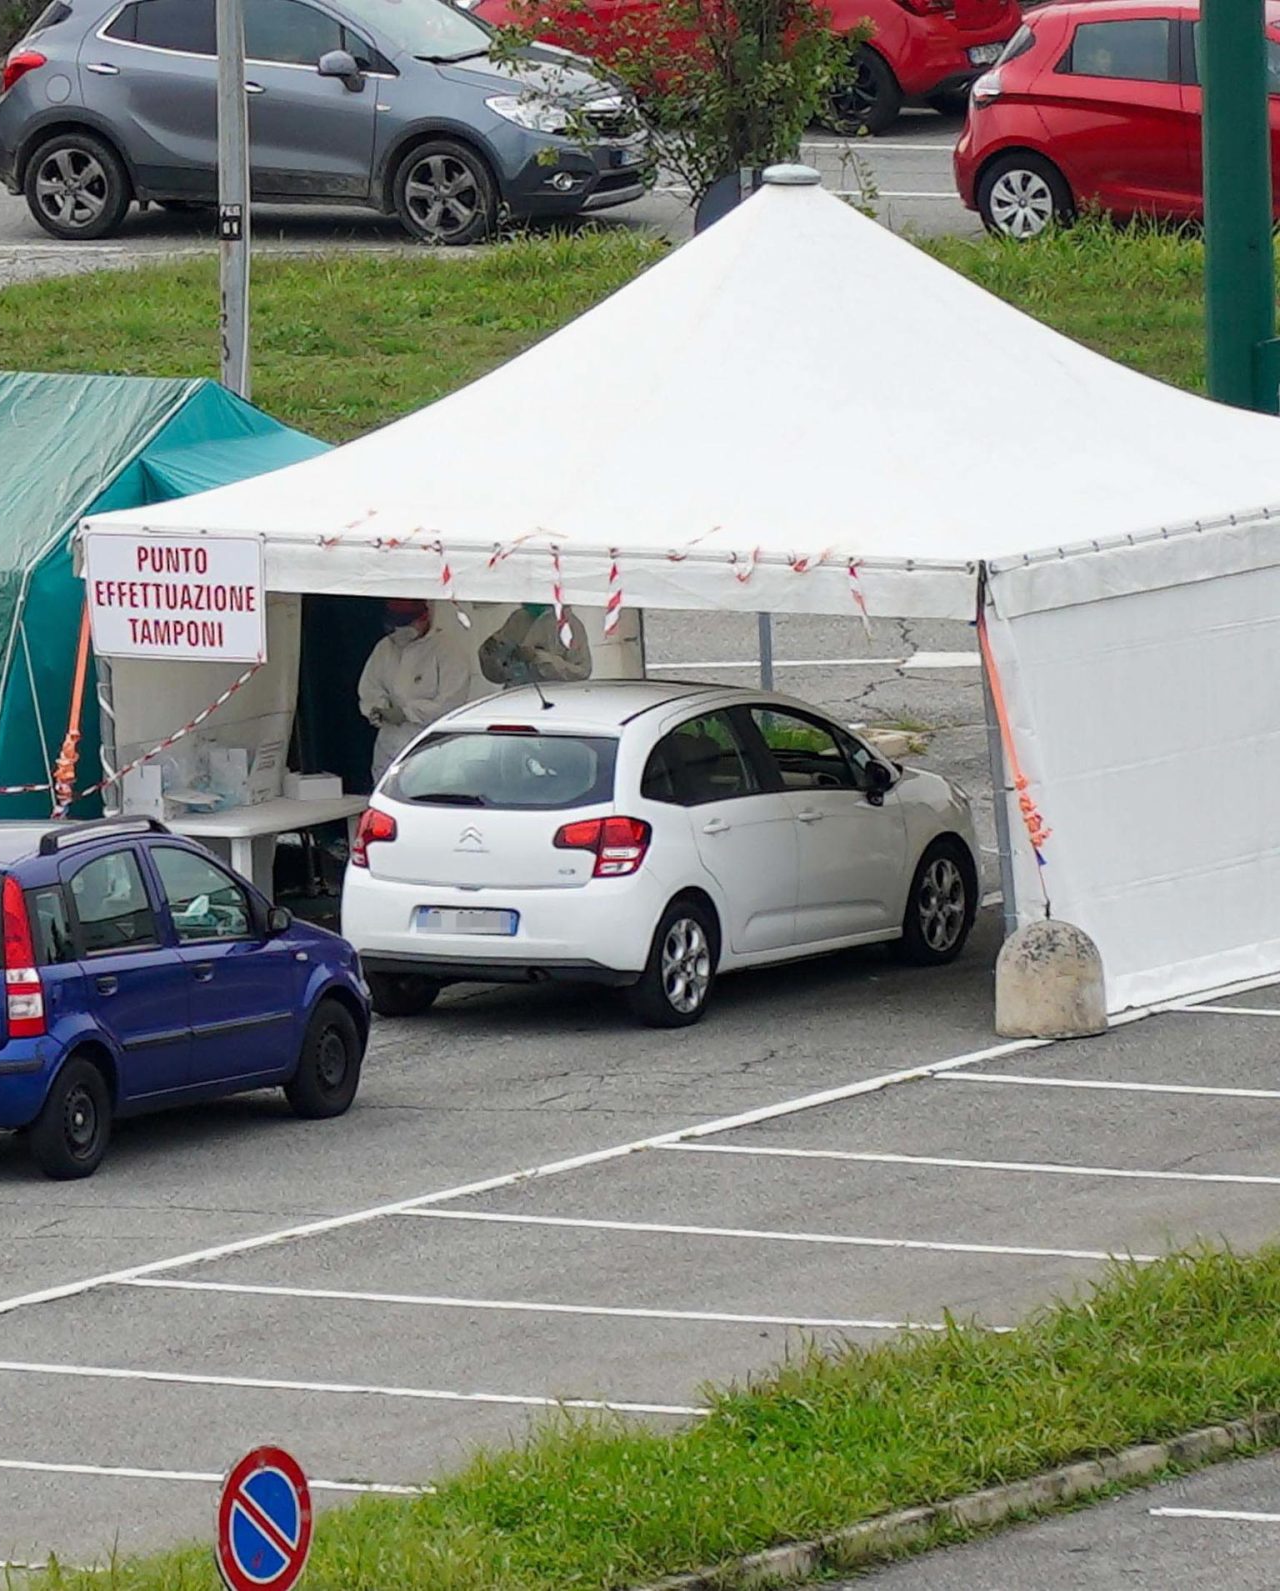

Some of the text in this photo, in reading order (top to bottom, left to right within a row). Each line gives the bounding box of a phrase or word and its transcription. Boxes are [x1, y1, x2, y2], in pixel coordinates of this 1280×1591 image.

[137, 546, 207, 574] PUNTO
[95, 581, 256, 612] EFFETTUAZIONE
[128, 618, 223, 647] TAMPONI
